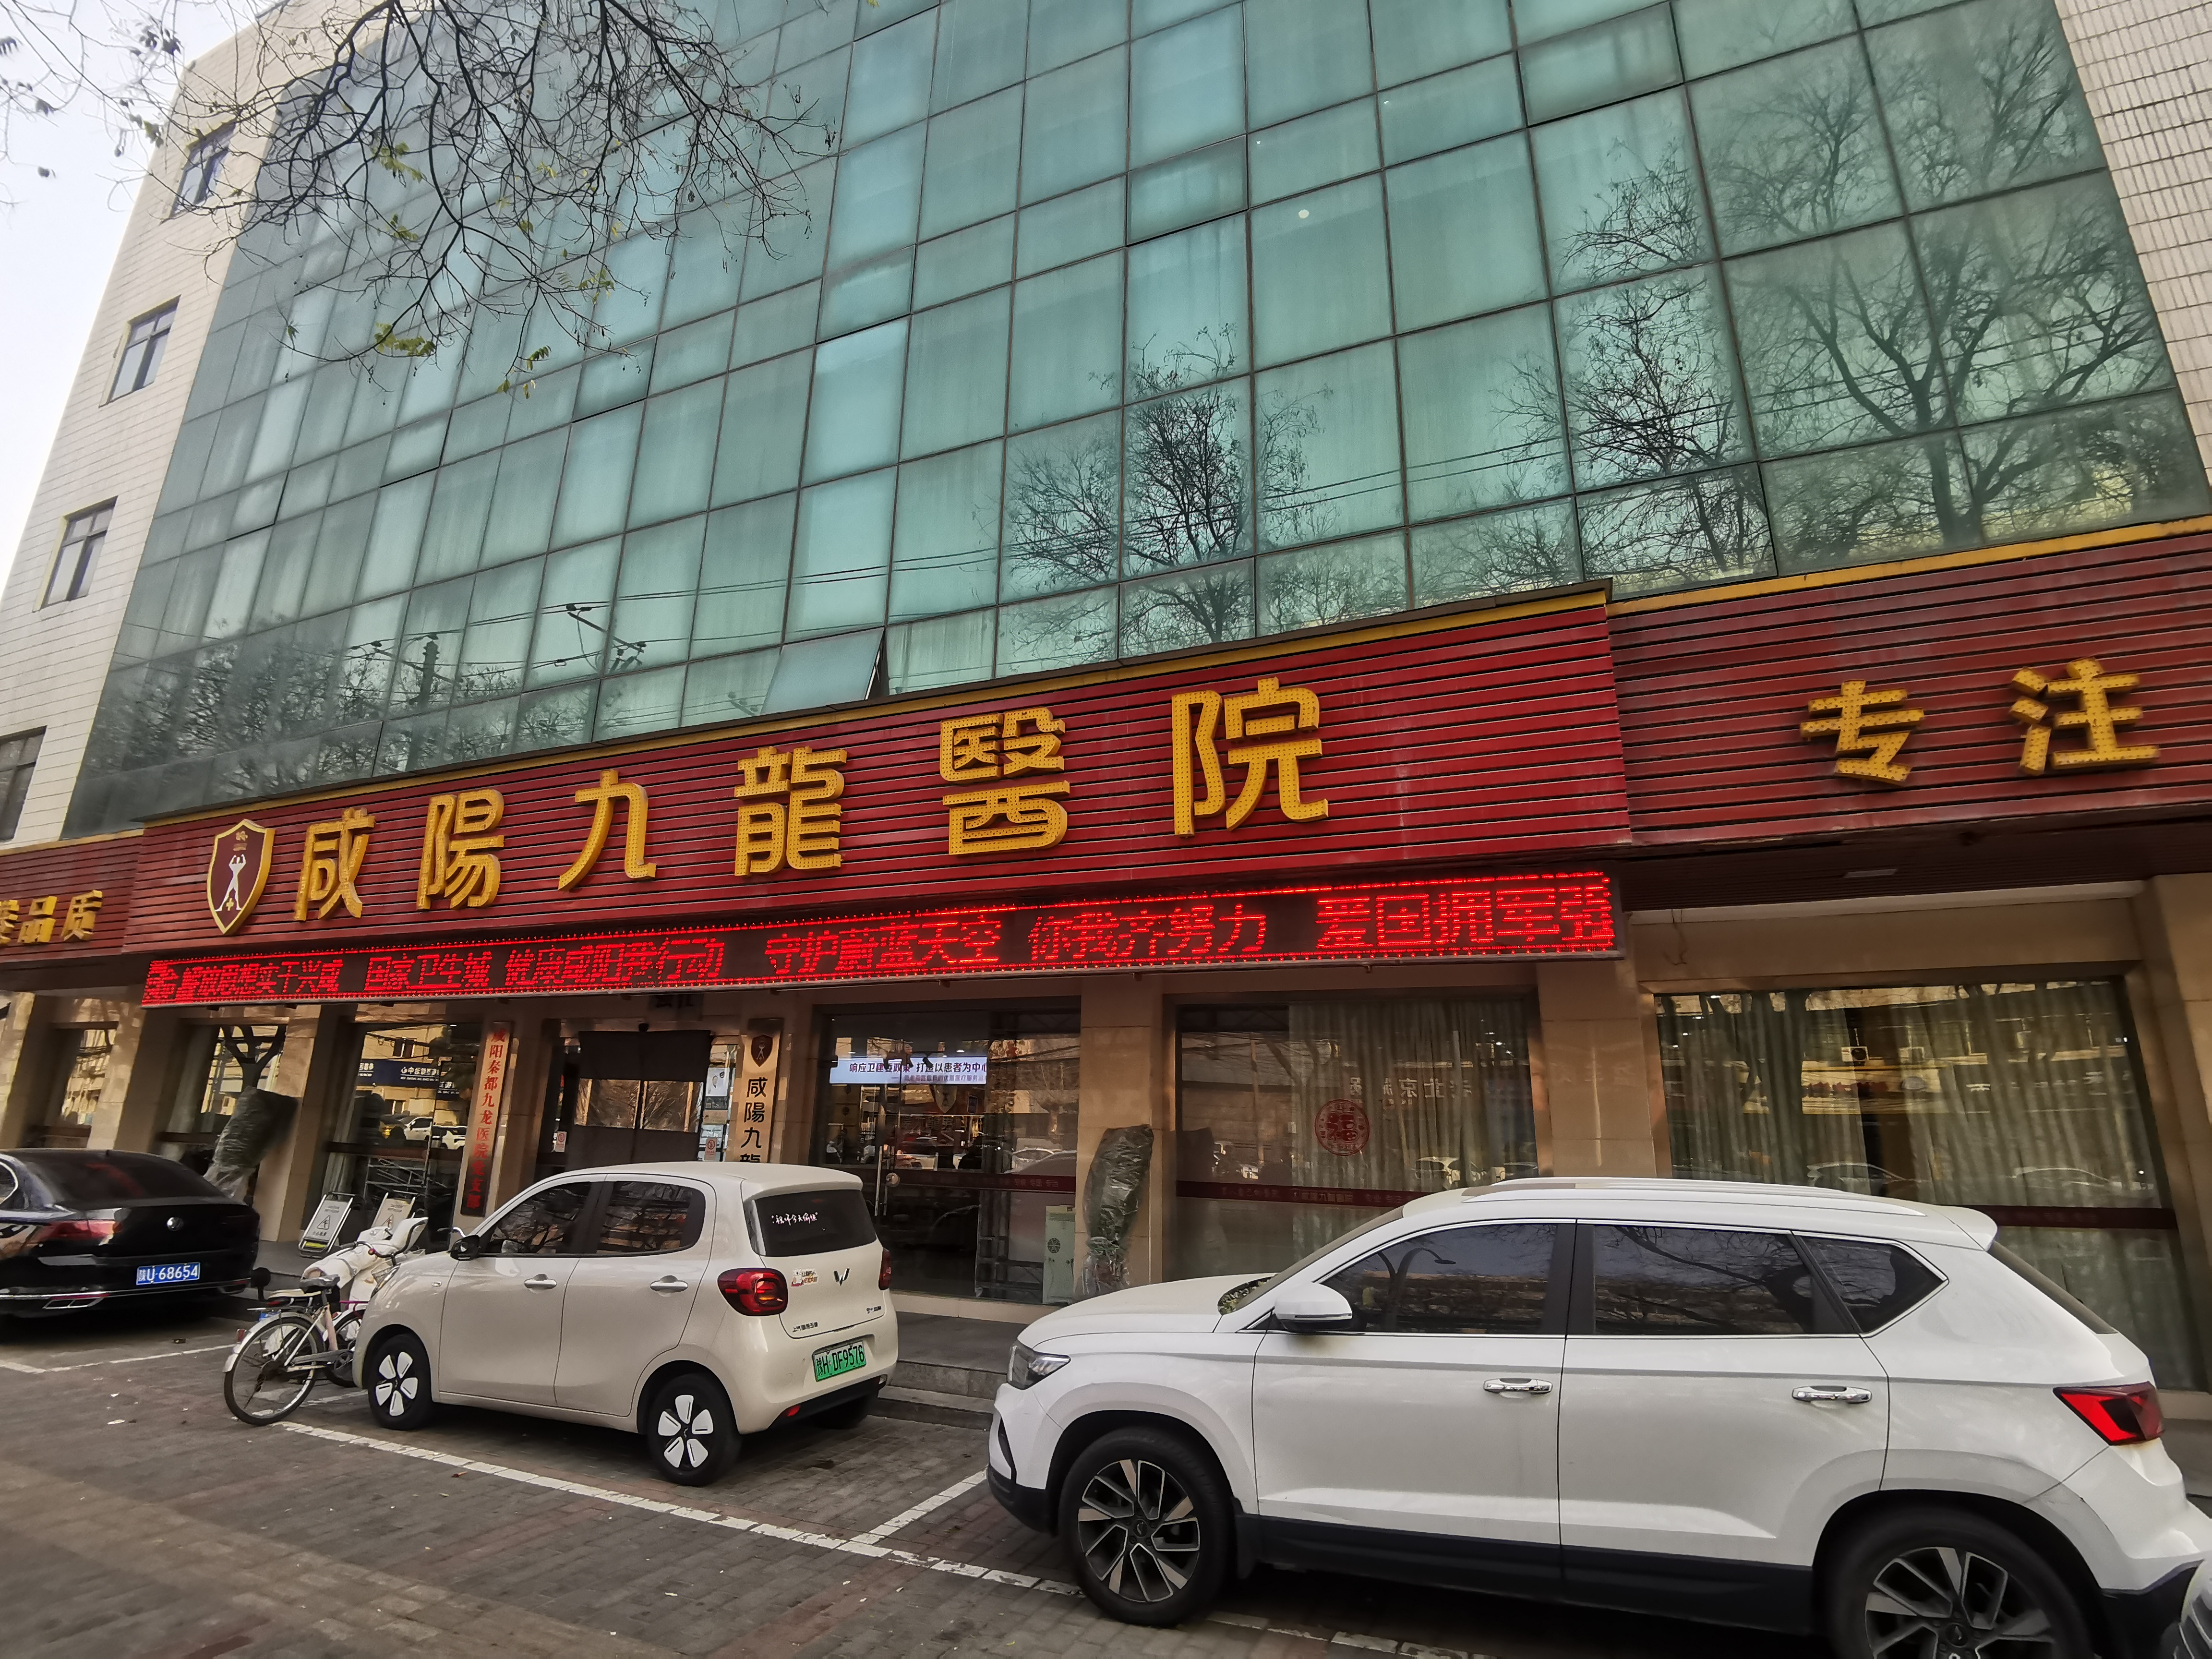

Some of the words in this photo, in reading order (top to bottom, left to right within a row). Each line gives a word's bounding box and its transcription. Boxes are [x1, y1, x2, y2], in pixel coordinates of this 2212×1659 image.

[294, 676, 1328, 922] 咸陽九龍醫院
[1800, 657, 2160, 786] 专注
[765, 914, 1000, 974] 守护蔚蓝天空
[1028, 903, 1266, 960] 你我齐努力
[467, 1028, 506, 1209] 咸阳秦都九龙医院党支部
